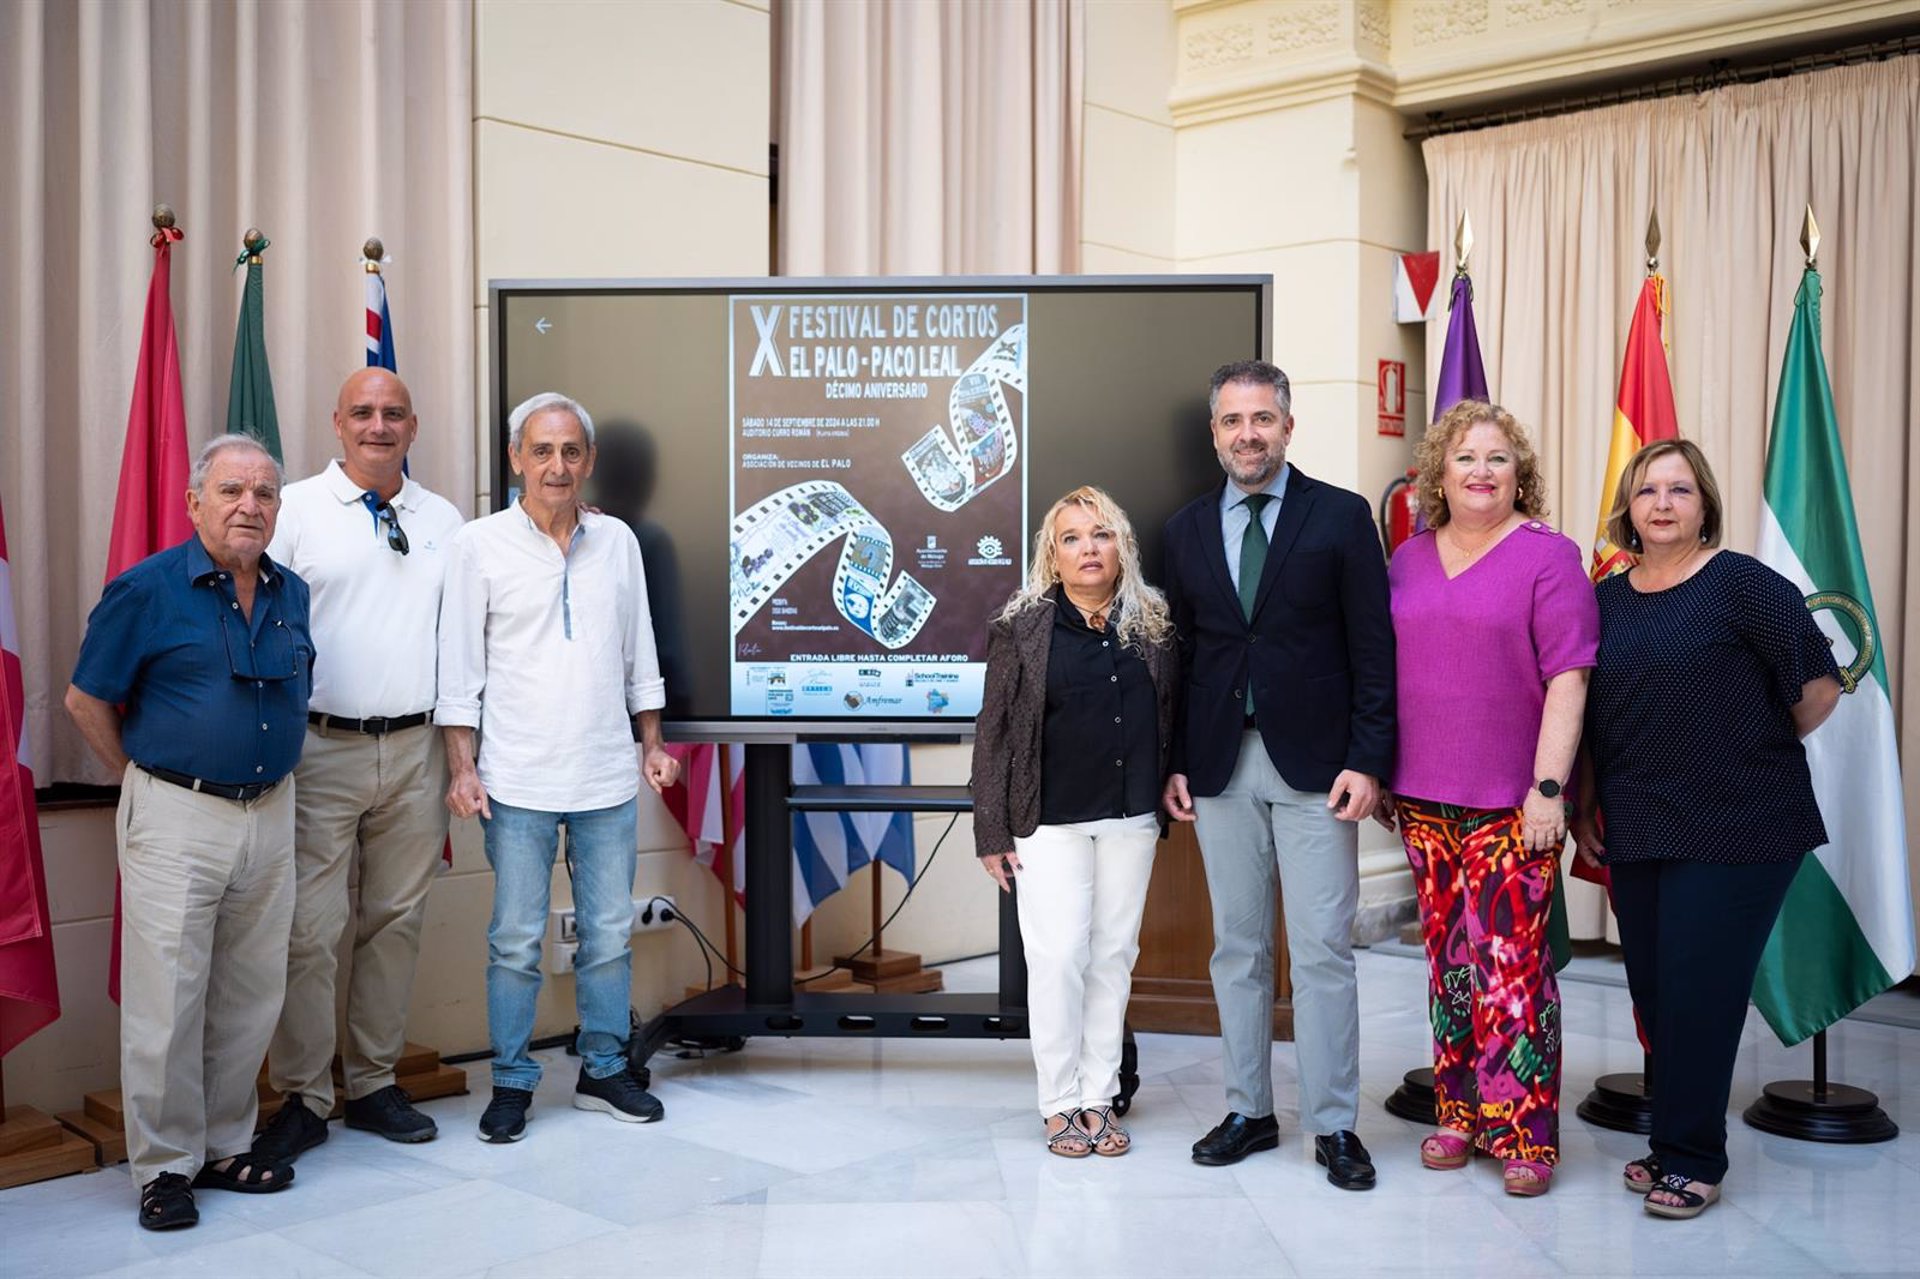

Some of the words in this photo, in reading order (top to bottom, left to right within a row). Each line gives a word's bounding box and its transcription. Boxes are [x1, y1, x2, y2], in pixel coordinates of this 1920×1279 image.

[789, 305, 887, 338] FESTIVAL
[893, 305, 920, 338] DE
[925, 304, 999, 338] CORTOS
[749, 305, 786, 377] X
[790, 346, 812, 378] EL
[815, 345, 858, 378] PALO
[871, 345, 916, 378] PACO
[919, 345, 962, 378] LEAL
[825, 379, 862, 399] DÉCIMO
[863, 382, 928, 399] ANIVERSARIO
[790, 654, 829, 662] ENTRADA
[831, 654, 857, 662] LIBRE
[857, 654, 886, 662] HASTA
[887, 654, 938, 662] COMPLETAR
[939, 654, 969, 662] AFORO
